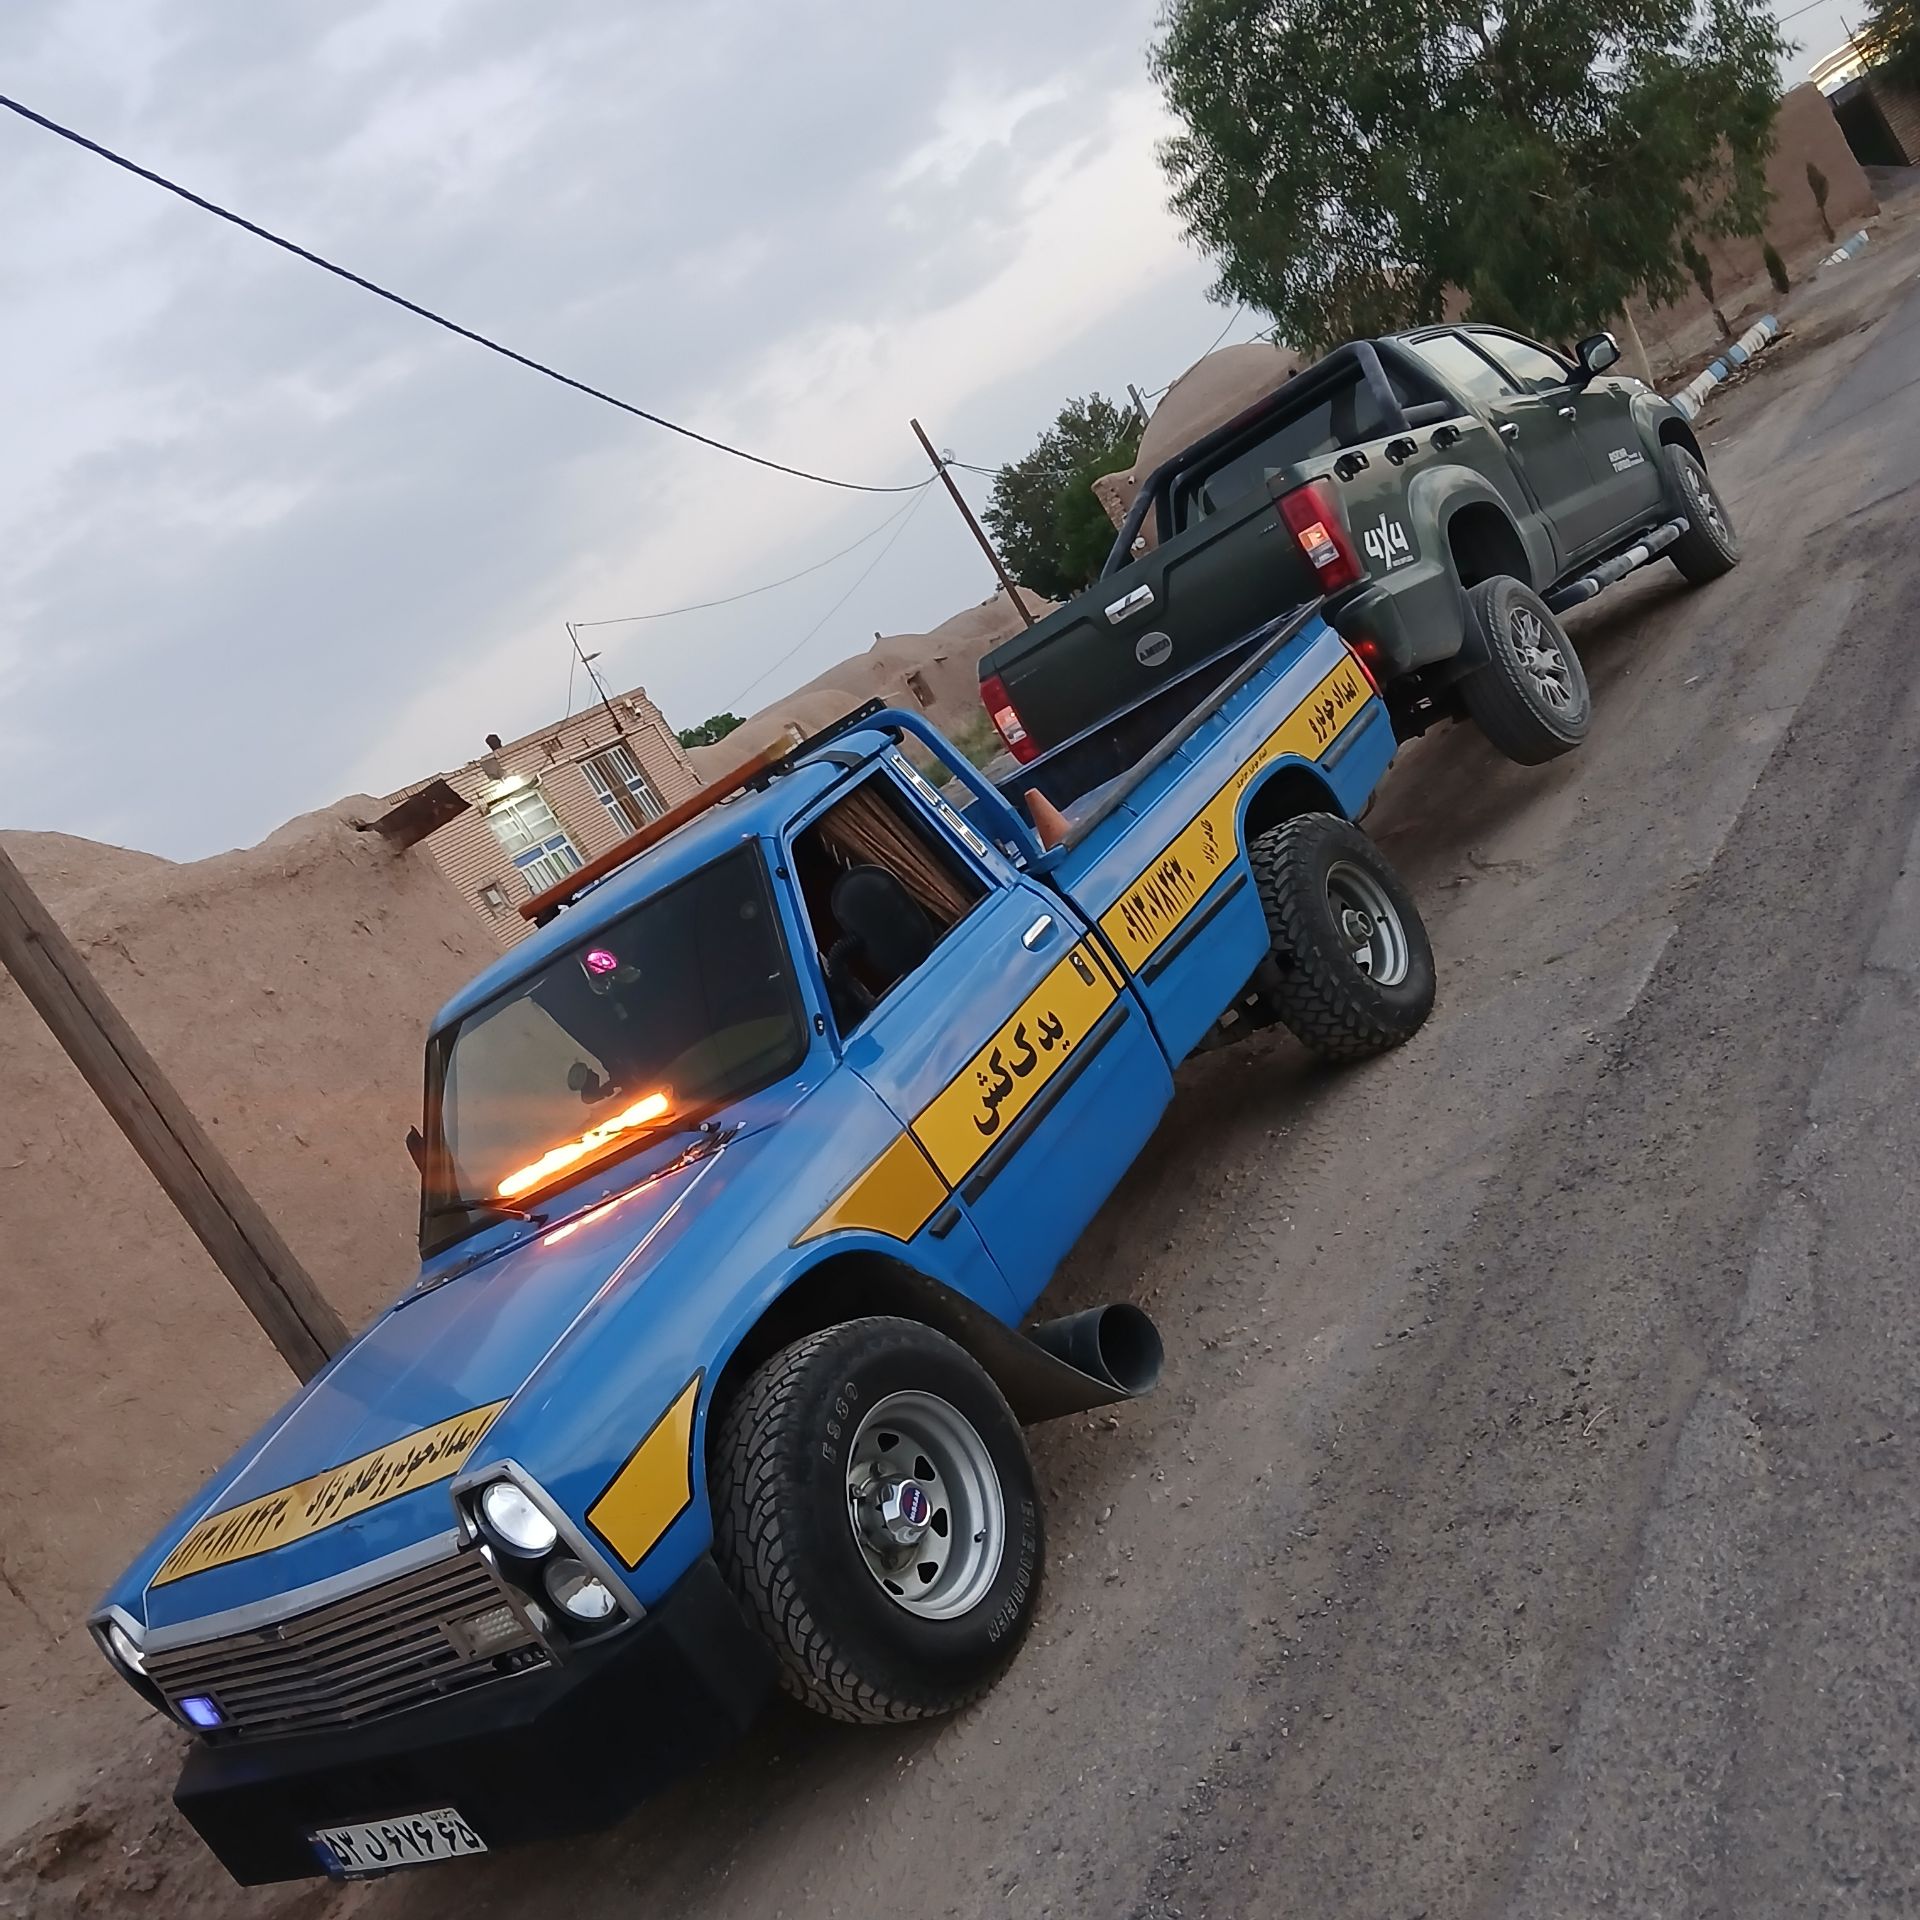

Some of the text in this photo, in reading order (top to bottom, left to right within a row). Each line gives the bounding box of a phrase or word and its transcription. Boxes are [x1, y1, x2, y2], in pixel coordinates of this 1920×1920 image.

[1308, 668, 1360, 744] امداد خودرو
[369, 1430, 442, 1501] خودرو
[429, 1411, 494, 1464] امداد
[908, 1489, 922, 1524] NISSAN
